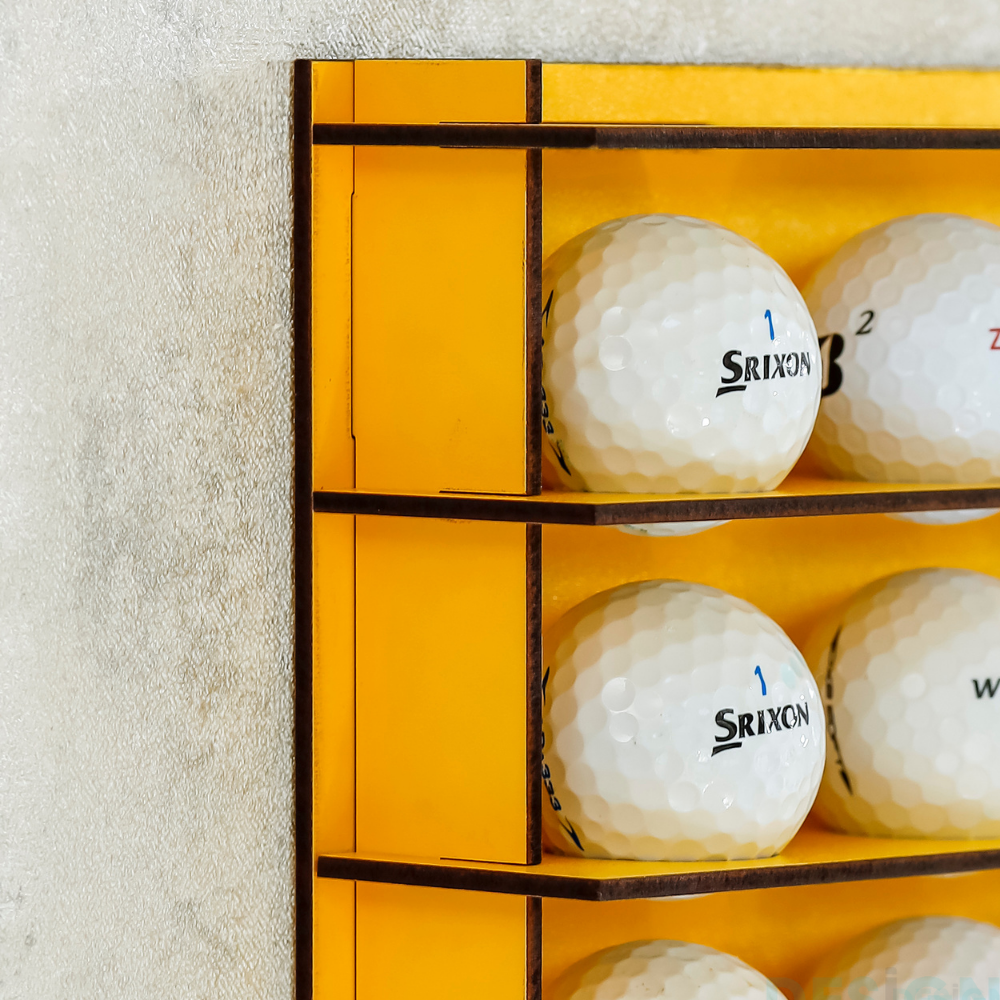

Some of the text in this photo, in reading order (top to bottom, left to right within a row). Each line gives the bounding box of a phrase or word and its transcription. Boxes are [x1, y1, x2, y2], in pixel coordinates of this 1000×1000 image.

[764, 309, 775, 341] 1
[855, 310, 875, 336] 2
[716, 350, 811, 398] SRIXON
[754, 665, 767, 696] 1
[711, 702, 809, 757] SRIXON
